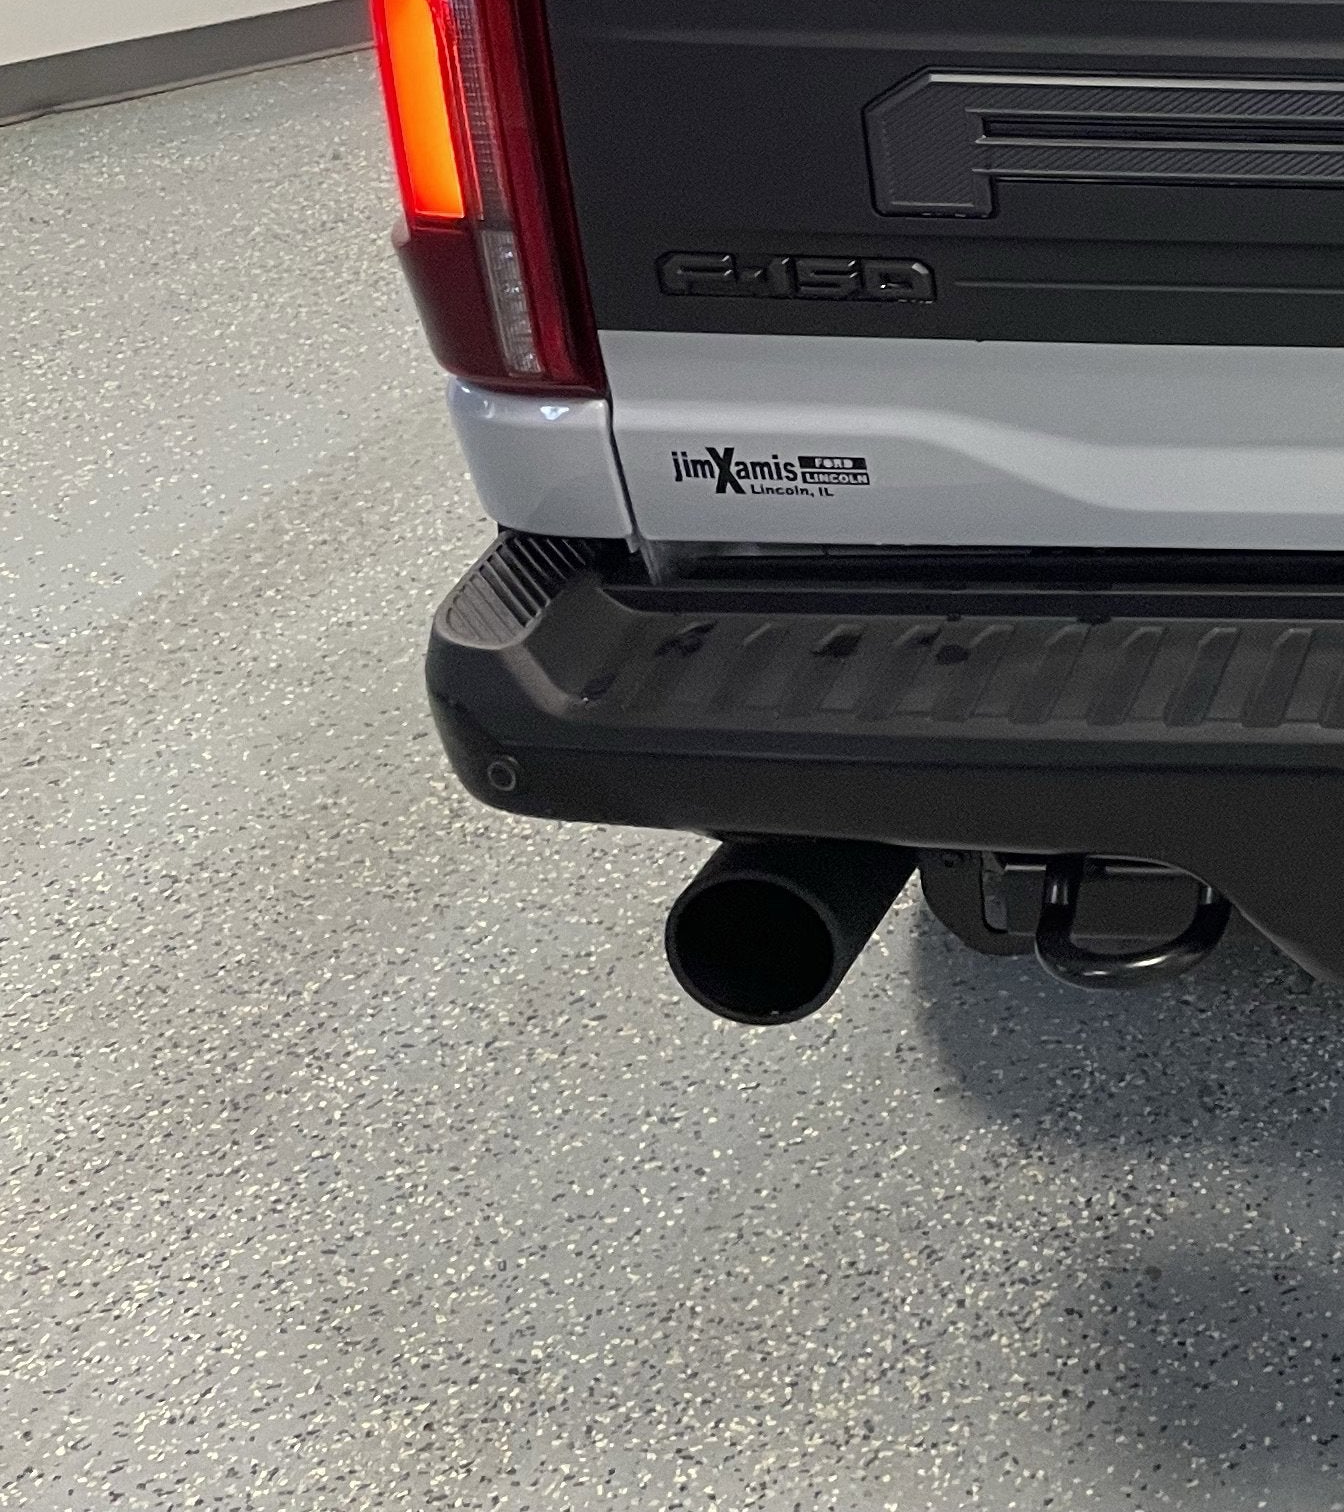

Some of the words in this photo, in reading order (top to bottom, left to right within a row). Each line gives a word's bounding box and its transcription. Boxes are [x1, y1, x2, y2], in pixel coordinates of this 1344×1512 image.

[656, 251, 936, 303] F-150
[814, 457, 854, 469] FORD
[671, 447, 798, 495] jimXamis
[805, 472, 868, 485] LINCOLN
[750, 484, 815, 498] Lincoln,
[818, 487, 835, 497] IL
